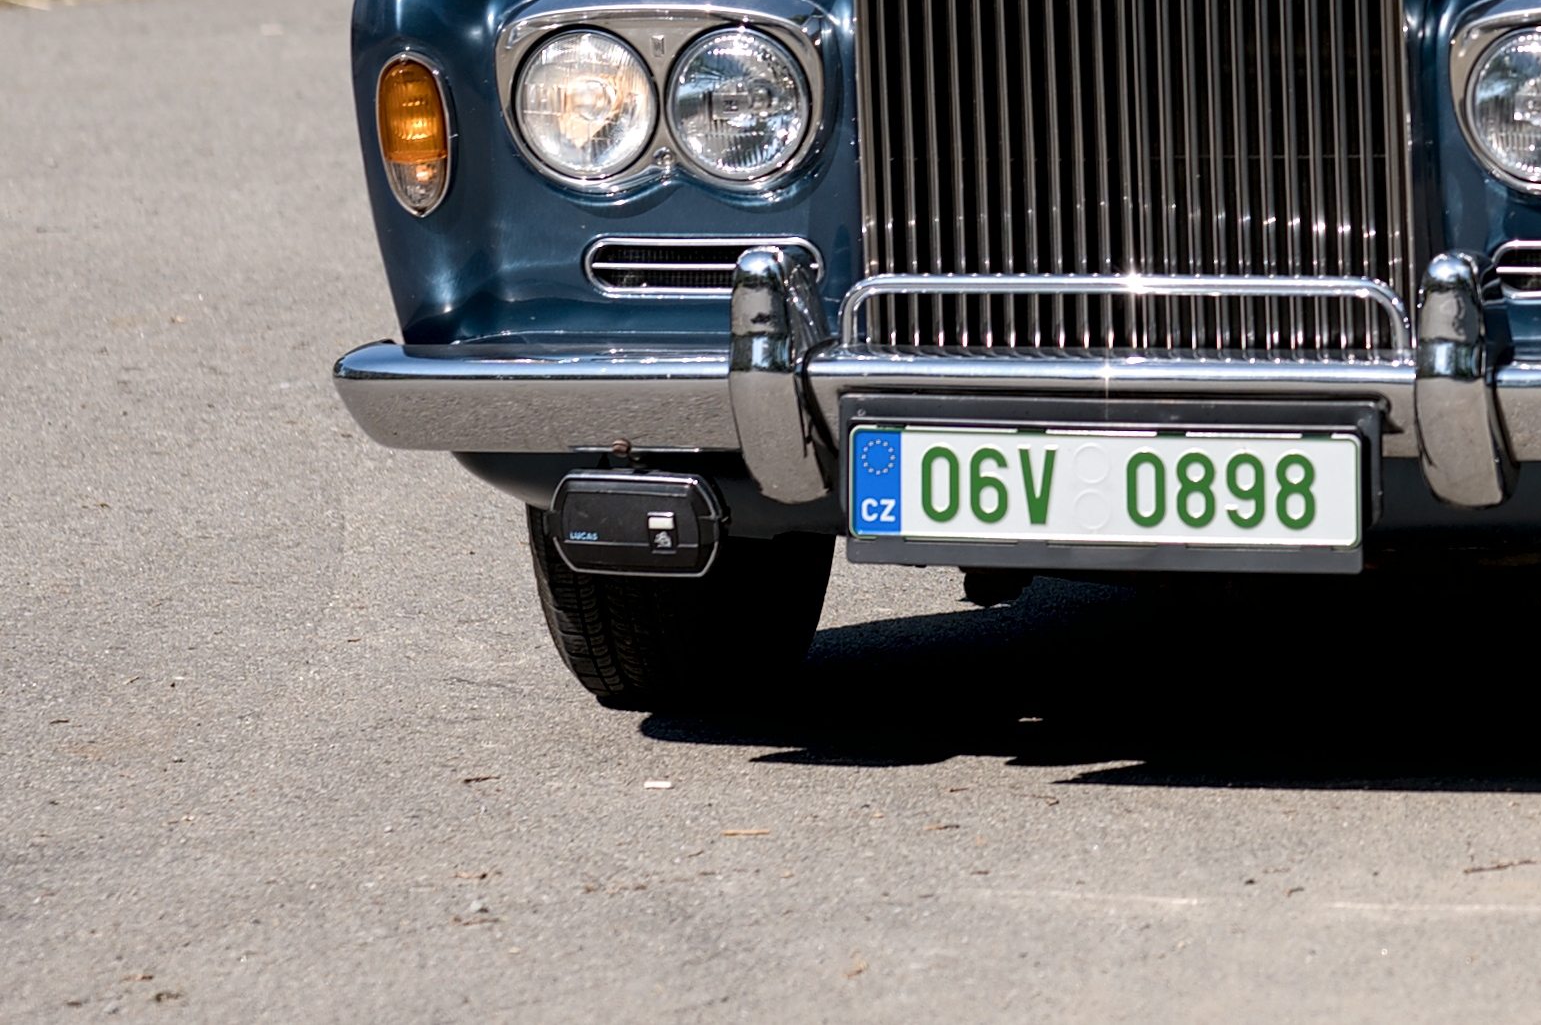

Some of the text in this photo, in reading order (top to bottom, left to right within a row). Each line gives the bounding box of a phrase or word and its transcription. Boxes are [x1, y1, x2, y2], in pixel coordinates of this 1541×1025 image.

[920, 445, 1316, 530] 06V 0898
[861, 499, 896, 522] CZ
[570, 531, 598, 540] LUCAS
